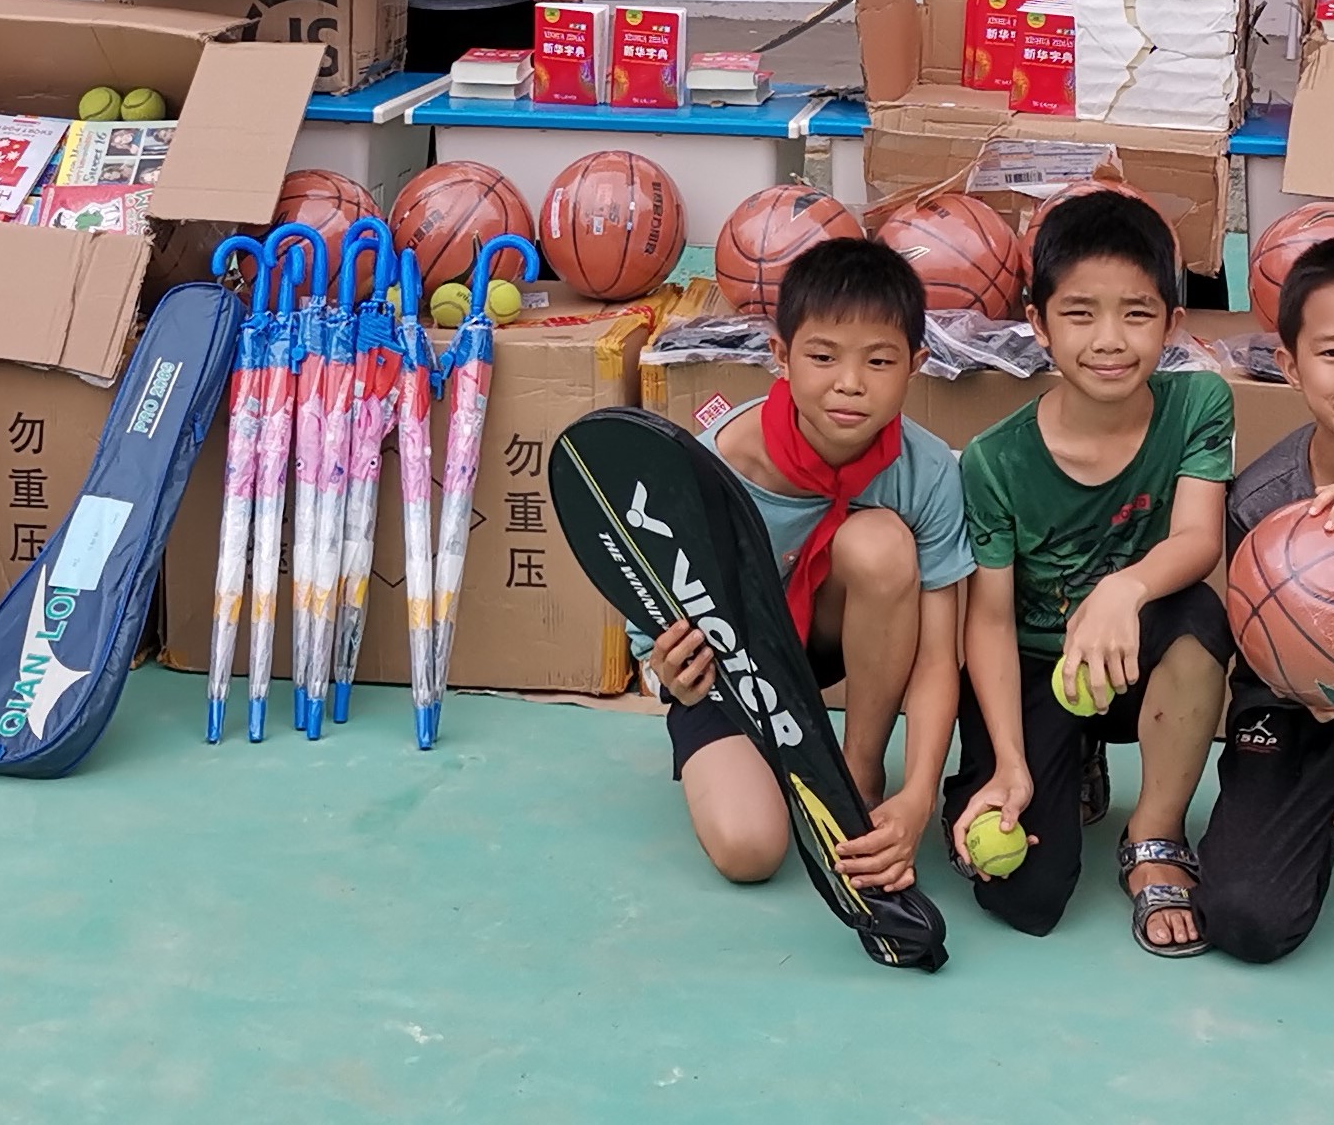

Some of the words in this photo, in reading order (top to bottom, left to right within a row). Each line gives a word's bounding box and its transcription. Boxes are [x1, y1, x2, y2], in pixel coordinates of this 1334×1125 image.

[542, 43, 586, 59] 新华字典
[623, 45, 669, 61] 新华字典
[1023, 48, 1074, 64] 新华字典
[8, 411, 49, 563] 勿重压
[503, 432, 548, 589] 勿重压
[597, 531, 628, 565] THE
